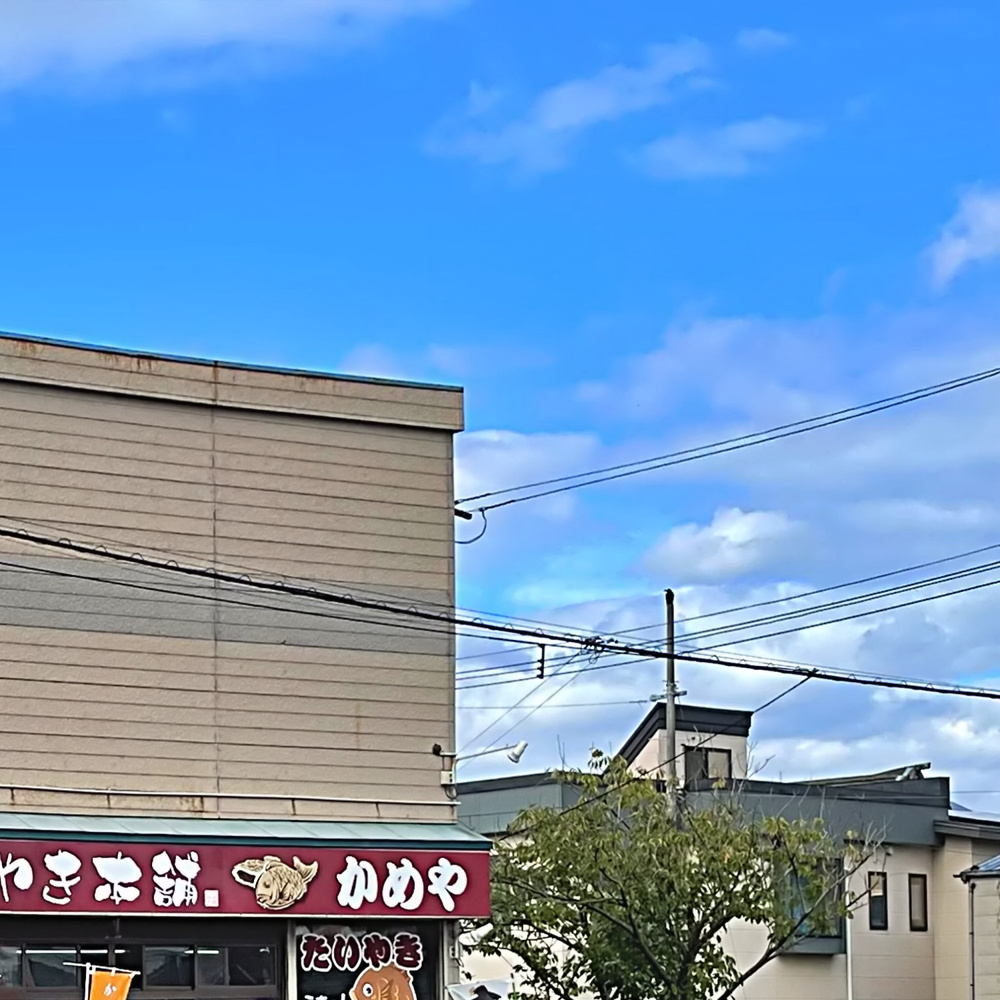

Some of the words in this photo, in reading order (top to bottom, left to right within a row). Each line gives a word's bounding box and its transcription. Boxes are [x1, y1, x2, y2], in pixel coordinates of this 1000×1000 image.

[336, 855, 468, 912] かめや
[301, 932, 423, 972] たいやき
